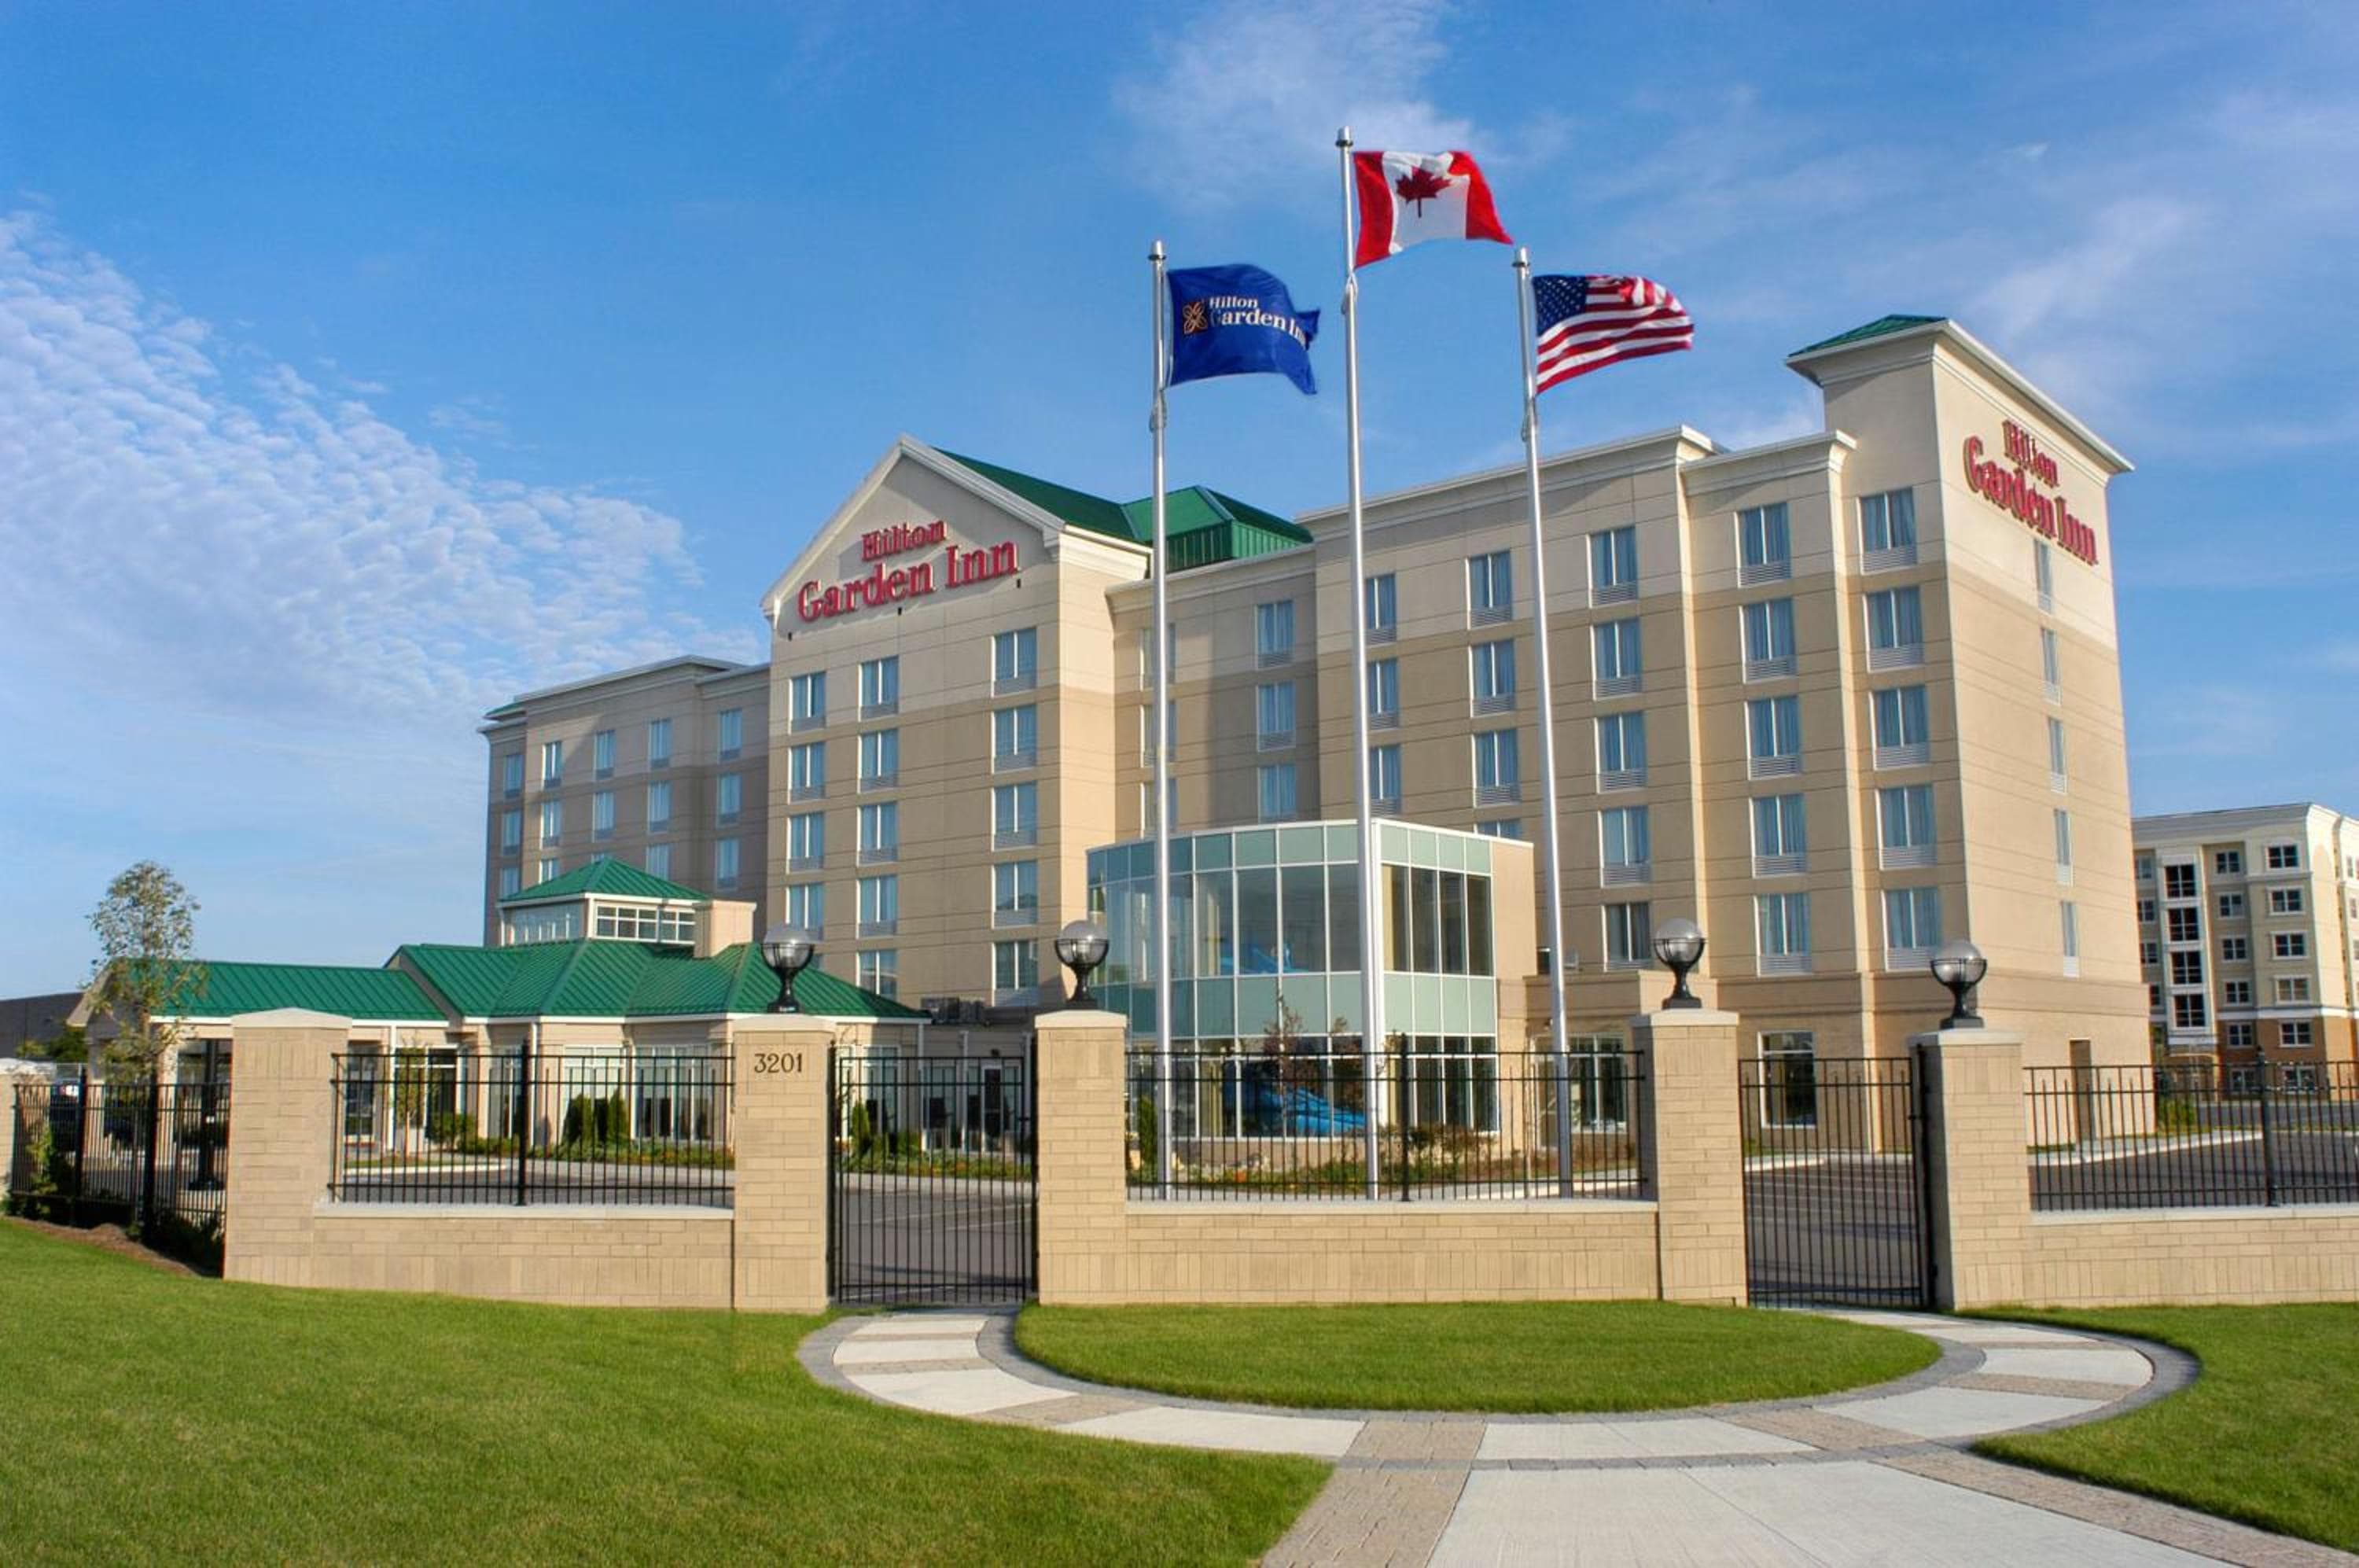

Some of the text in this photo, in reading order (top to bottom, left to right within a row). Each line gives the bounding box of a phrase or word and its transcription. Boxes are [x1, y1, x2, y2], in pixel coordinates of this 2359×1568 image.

[1209, 296, 1258, 308] Hilton
[2002, 420, 2059, 488] Hilton
[1963, 436, 2099, 566] Garden Inn
[862, 518, 946, 561] Hilton
[798, 540, 1018, 622] Garden Inn
[754, 1053, 802, 1073] 3201
